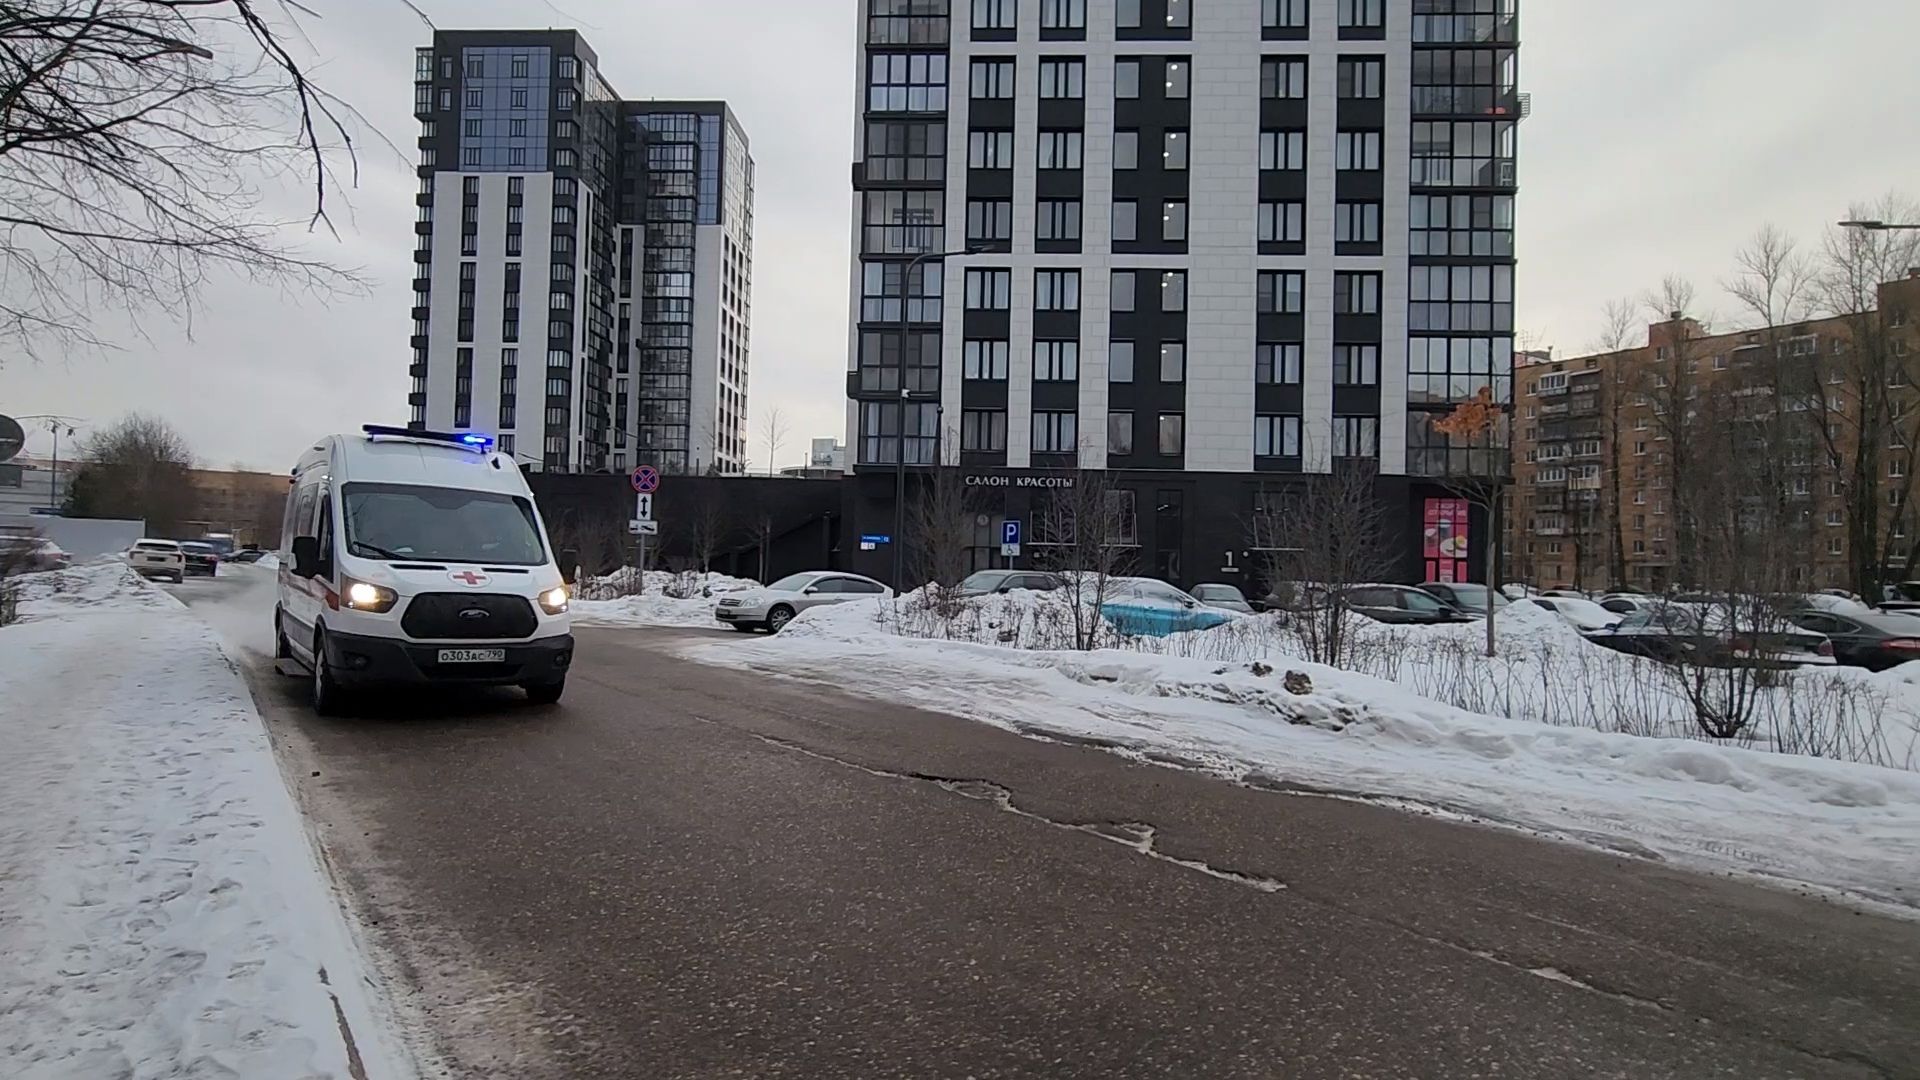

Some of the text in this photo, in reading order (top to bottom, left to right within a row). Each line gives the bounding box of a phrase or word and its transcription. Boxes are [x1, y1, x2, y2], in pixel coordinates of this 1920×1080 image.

[965, 476, 1073, 487] САЛОН КРАСОТЫ
[1006, 524, 1017, 542] P
[1225, 551, 1233, 567] 1
